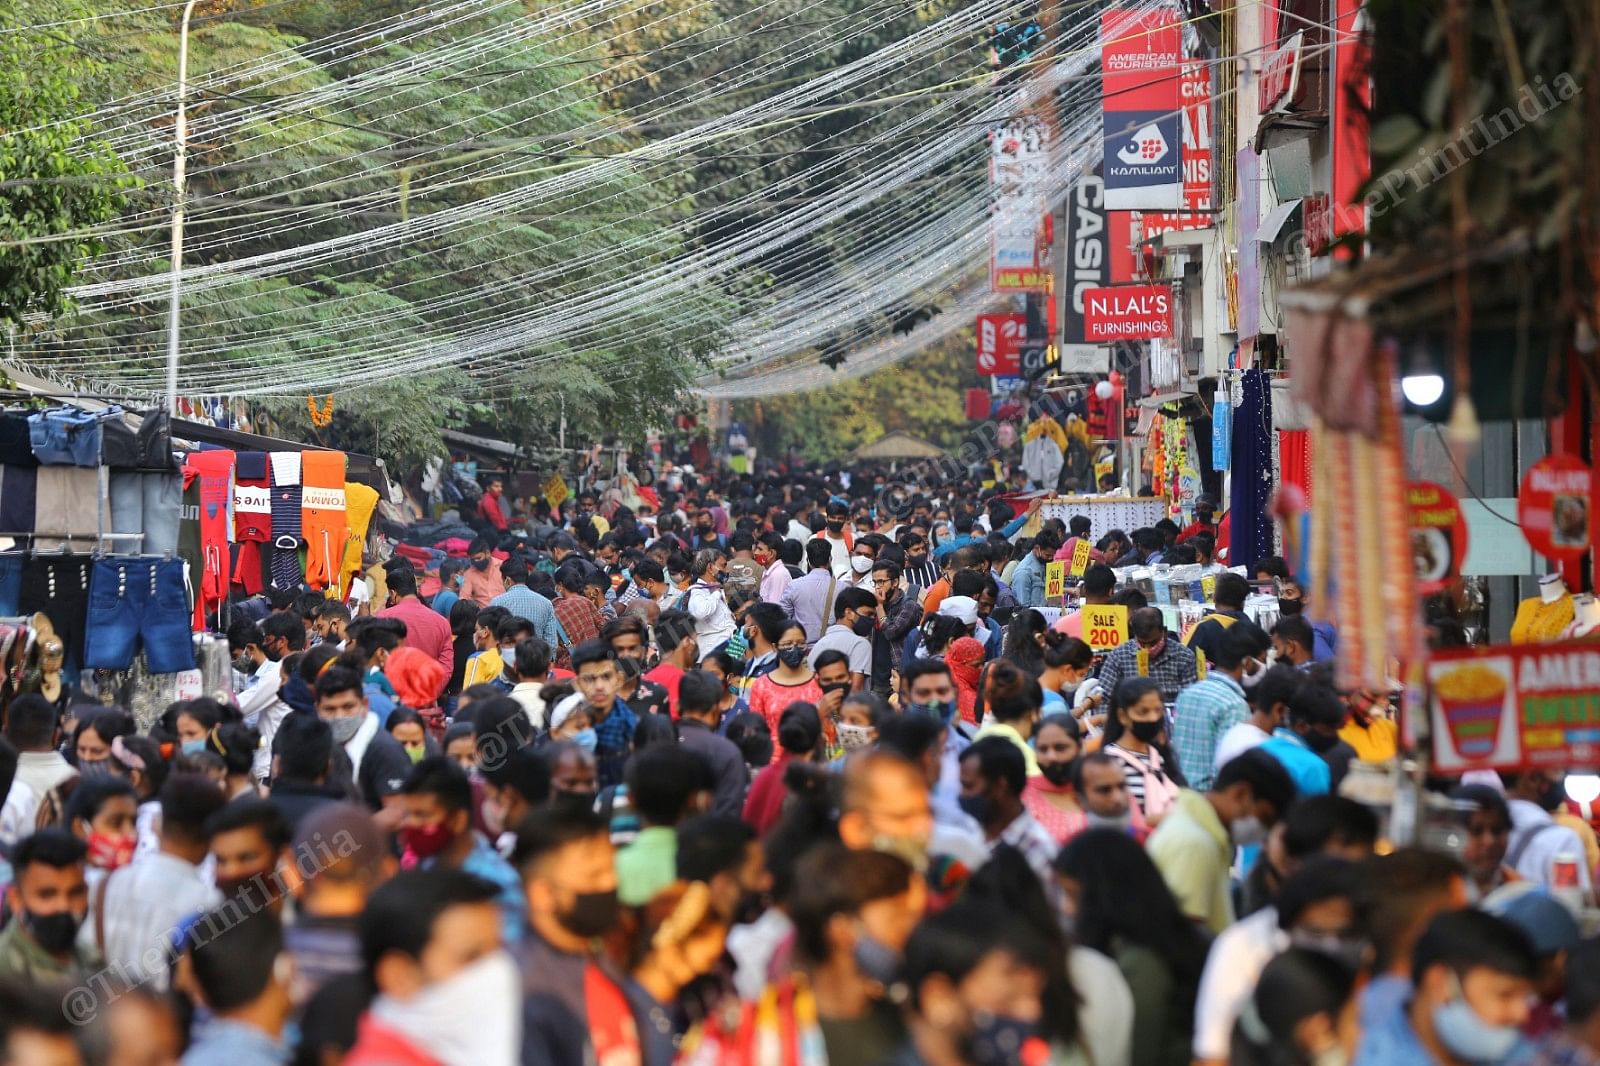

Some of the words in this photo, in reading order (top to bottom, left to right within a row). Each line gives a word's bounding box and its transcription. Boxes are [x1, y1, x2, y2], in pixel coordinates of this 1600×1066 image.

[1108, 53, 1176, 61] AMERICAN
[1108, 60, 1176, 69] TOURISTER
[1110, 166, 1176, 176] KAMILIANT
[1091, 295, 1168, 316] N.LAL'S
[1092, 320, 1168, 335] FURNISHINGS
[304, 495, 345, 506] TOMMY
[1076, 543, 1090, 554] SALE
[1073, 554, 1086, 567] 100
[1048, 580, 1060, 597] 100
[1093, 614, 1115, 627] SALE
[1090, 629, 1119, 646] 200
